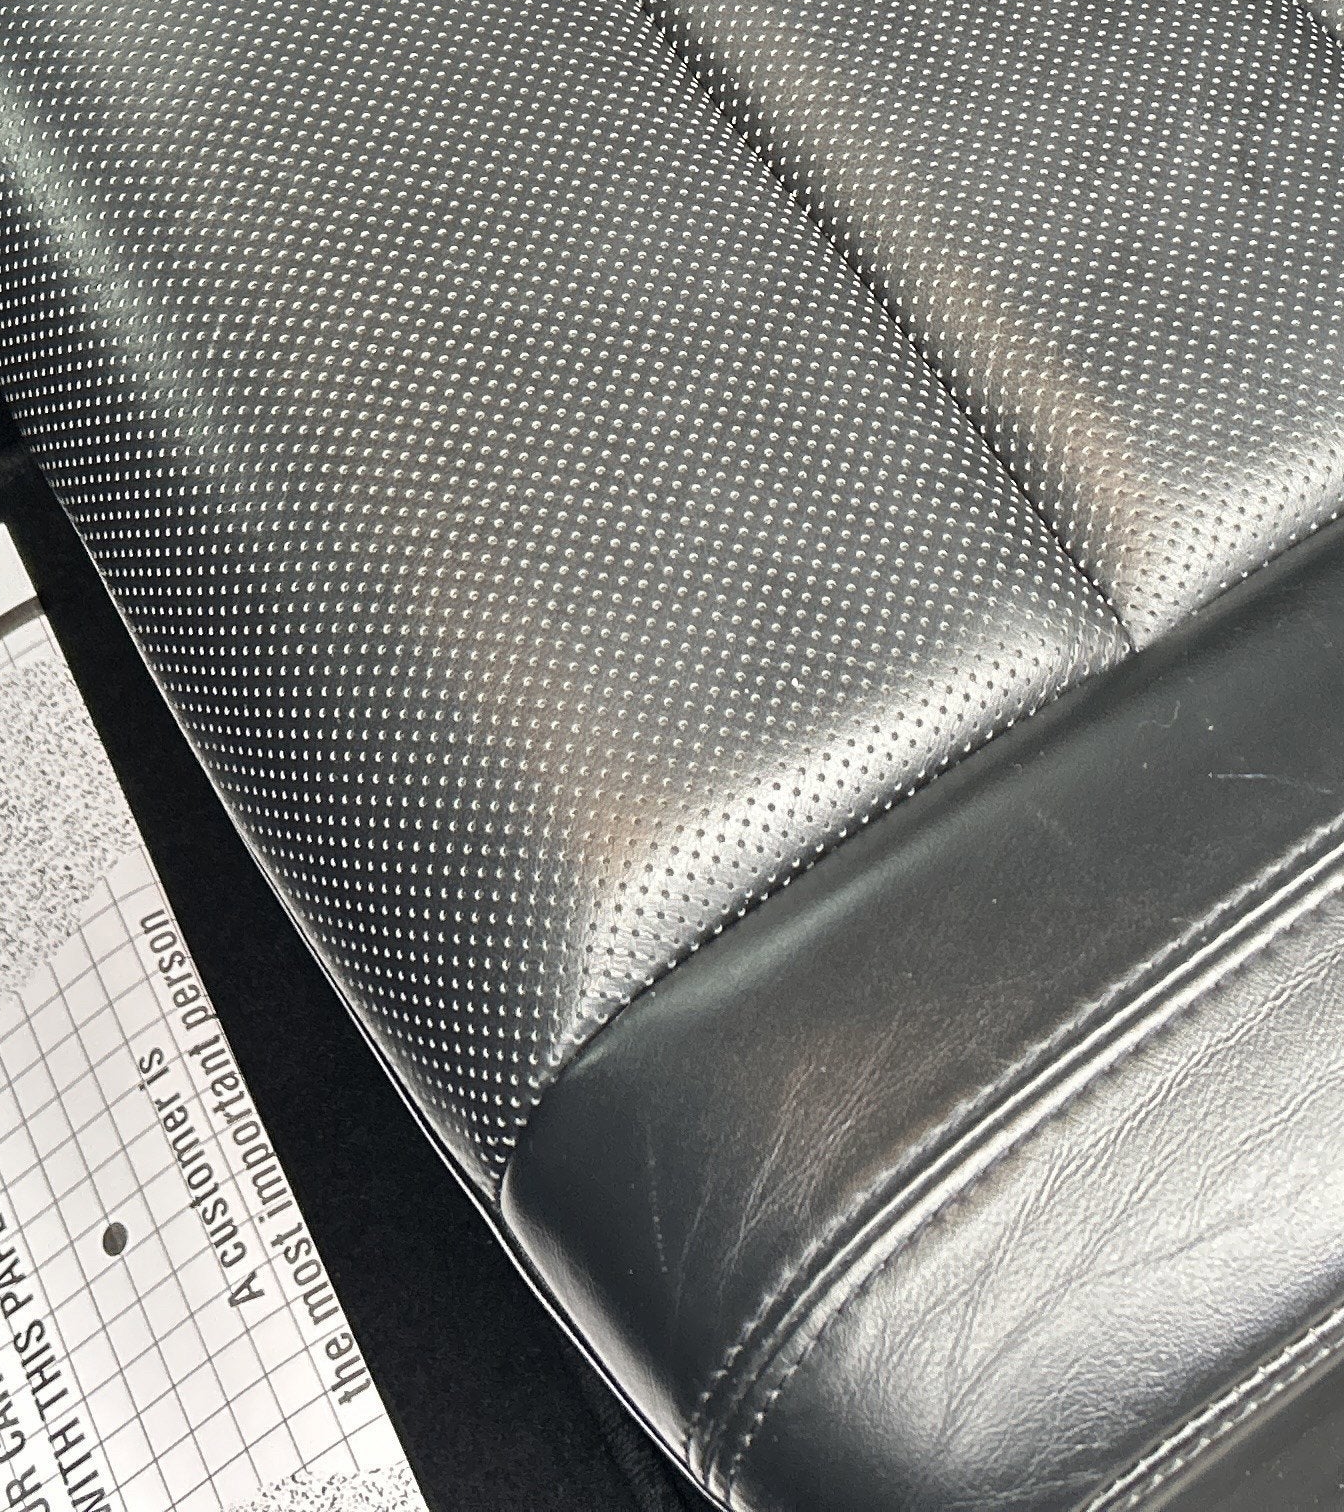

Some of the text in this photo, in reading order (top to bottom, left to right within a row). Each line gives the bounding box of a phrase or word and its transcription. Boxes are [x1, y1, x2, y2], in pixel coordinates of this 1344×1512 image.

[135, 1046, 266, 1308] A customer is
[137, 908, 372, 1405] the most important person
[13, 1319, 69, 1421] THIS
